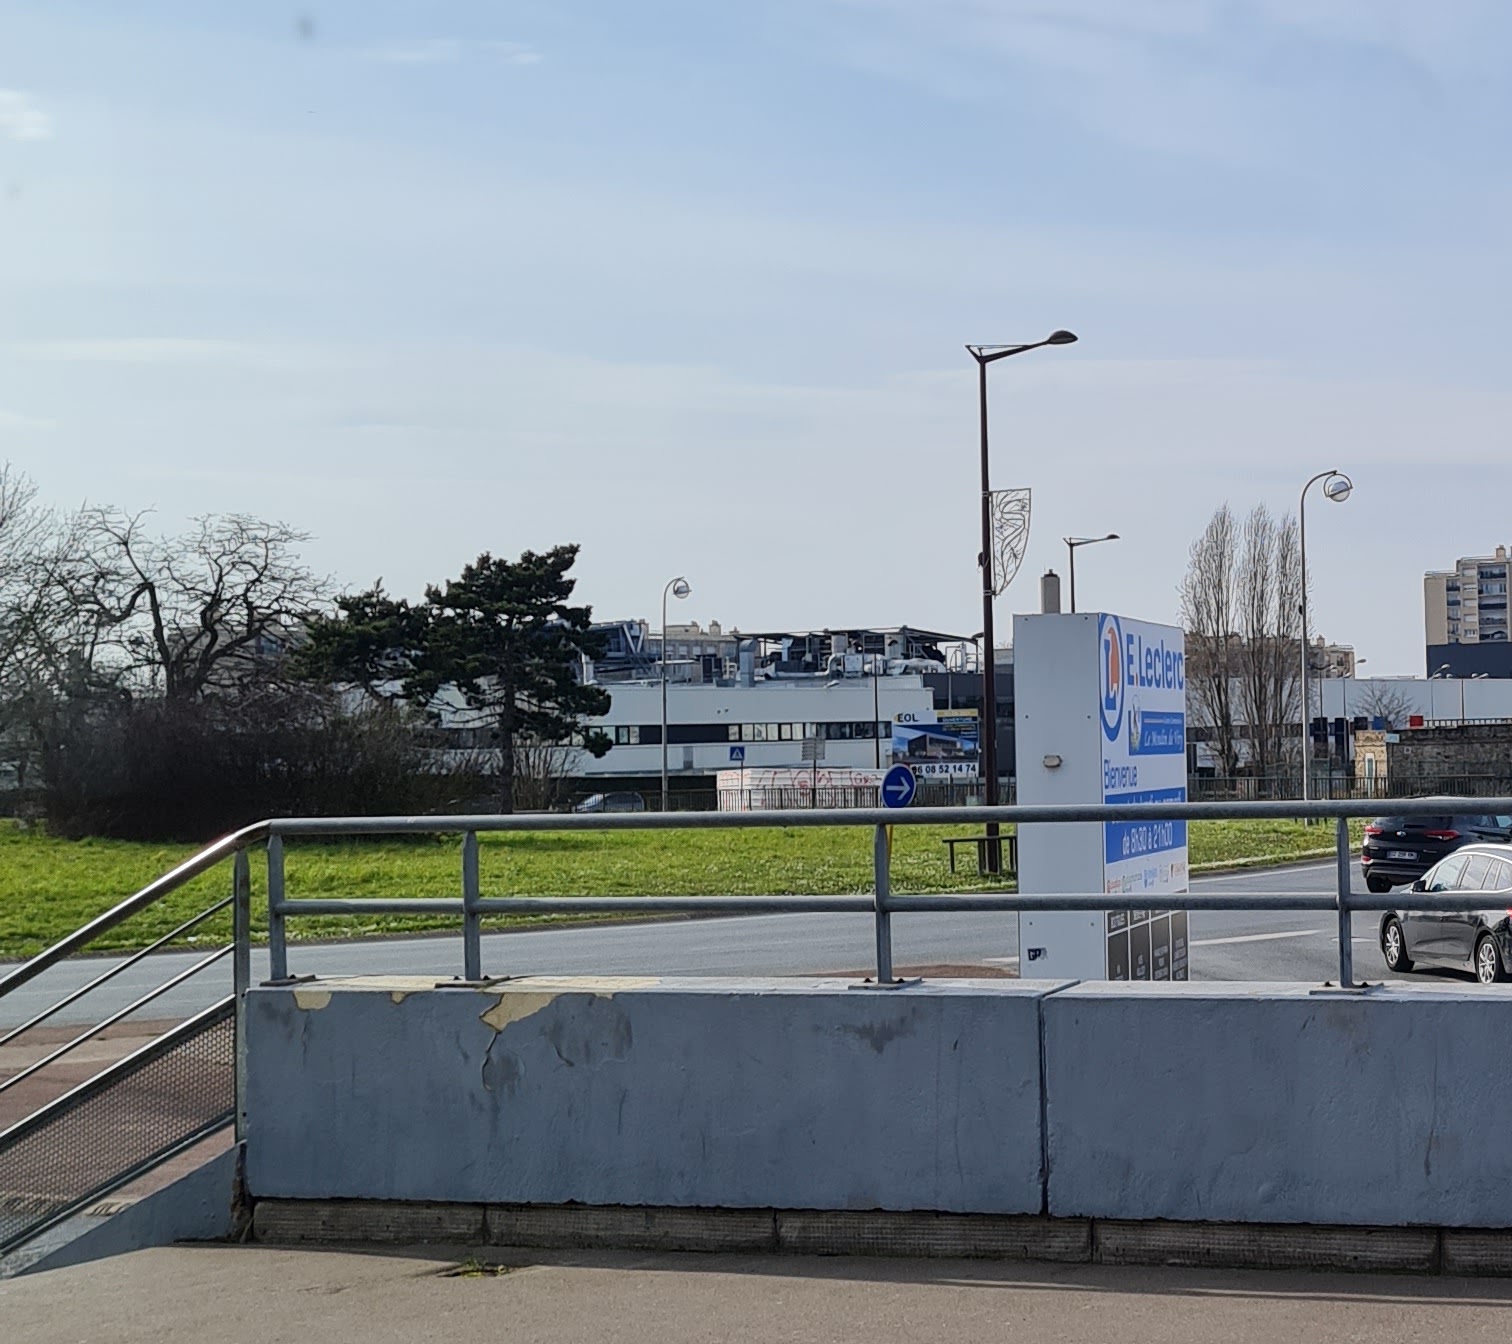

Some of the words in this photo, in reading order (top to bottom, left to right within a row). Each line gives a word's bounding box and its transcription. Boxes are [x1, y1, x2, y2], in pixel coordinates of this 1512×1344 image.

[1126, 633, 1184, 691] E.Leclerc
[897, 713, 921, 723] EOL
[925, 765, 937, 774] 08
[938, 764, 950, 774] 52
[953, 764, 964, 774] 14
[965, 764, 977, 773] 74
[1103, 758, 1138, 790] Bienvenue
[1122, 828, 1131, 856] de
